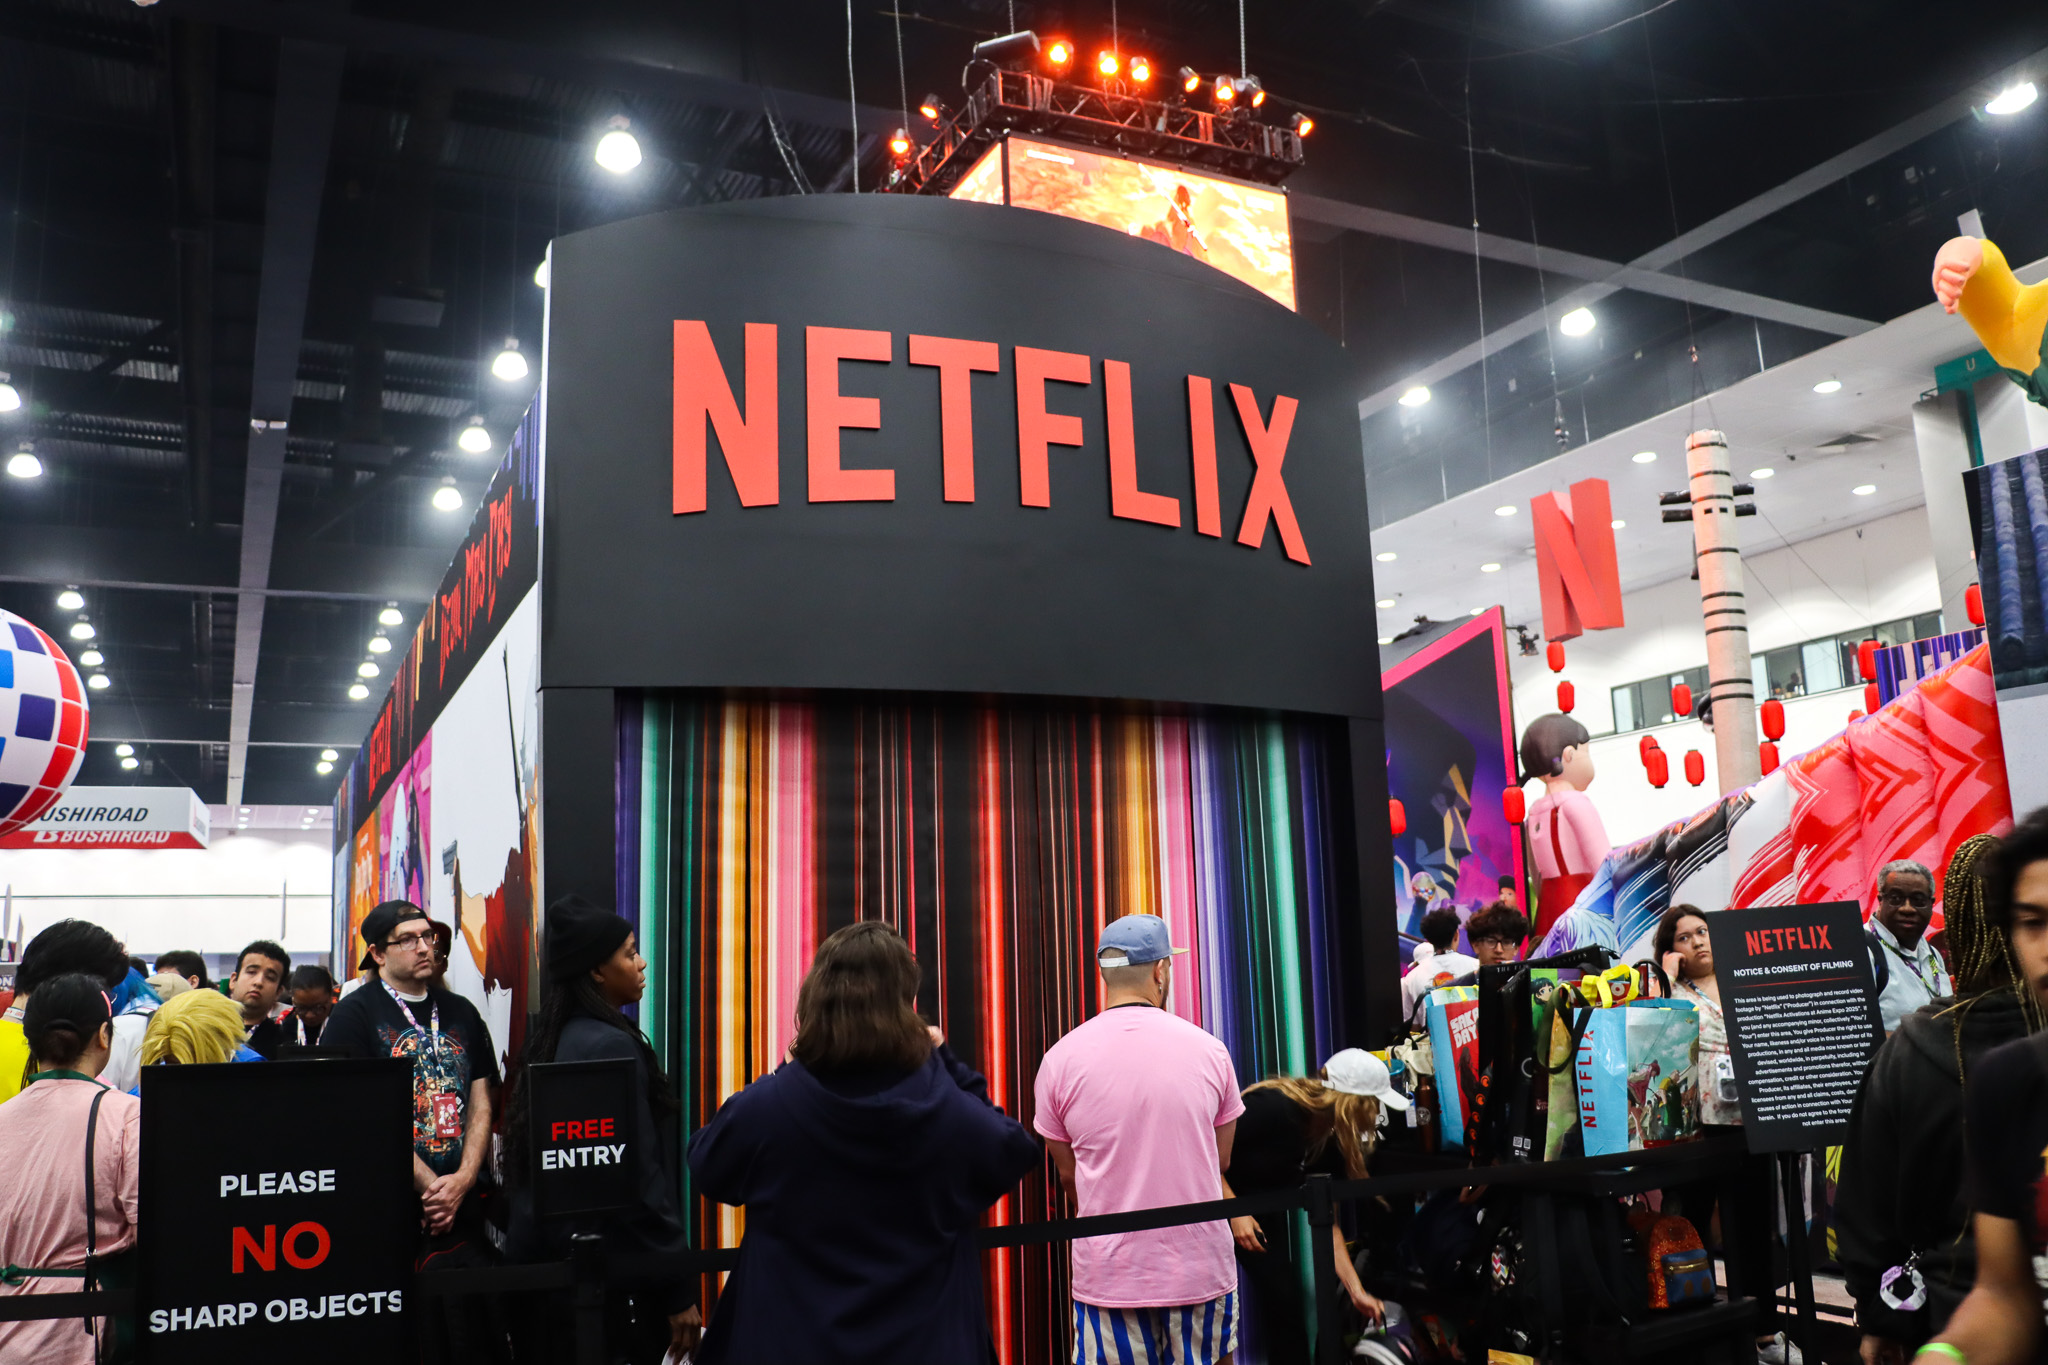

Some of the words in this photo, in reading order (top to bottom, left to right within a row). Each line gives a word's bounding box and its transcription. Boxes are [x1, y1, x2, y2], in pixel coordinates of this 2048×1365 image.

[672, 319, 1312, 566] NETFLIX
[40, 807, 149, 822] USHIROAD
[60, 831, 171, 843] BUSHIROAD
[1745, 925, 1832, 956] NETFLIX
[1733, 967, 1763, 977] NOTICE
[1764, 966, 1771, 975] &
[1771, 963, 1808, 974] CONSENT
[1809, 962, 1821, 971] OF
[1821, 960, 1854, 970] FILMING
[1795, 991, 1824, 1000] photograph
[1736, 1015, 1764, 1023] production
[1772, 1020, 1808, 1028] accompanying
[1802, 1028, 1814, 1036] give
[1578, 1030, 1597, 1128] NETFLIX
[1755, 1067, 1793, 1075] advertisements
[1803, 1064, 1831, 1072] promotions
[551, 1118, 615, 1142] FREE
[541, 1143, 627, 1170] ENTRY
[220, 1169, 336, 1198] PLEASE
[231, 1221, 331, 1274] NO
[149, 1302, 258, 1334] SHARP
[264, 1289, 402, 1323] OBJECTS
